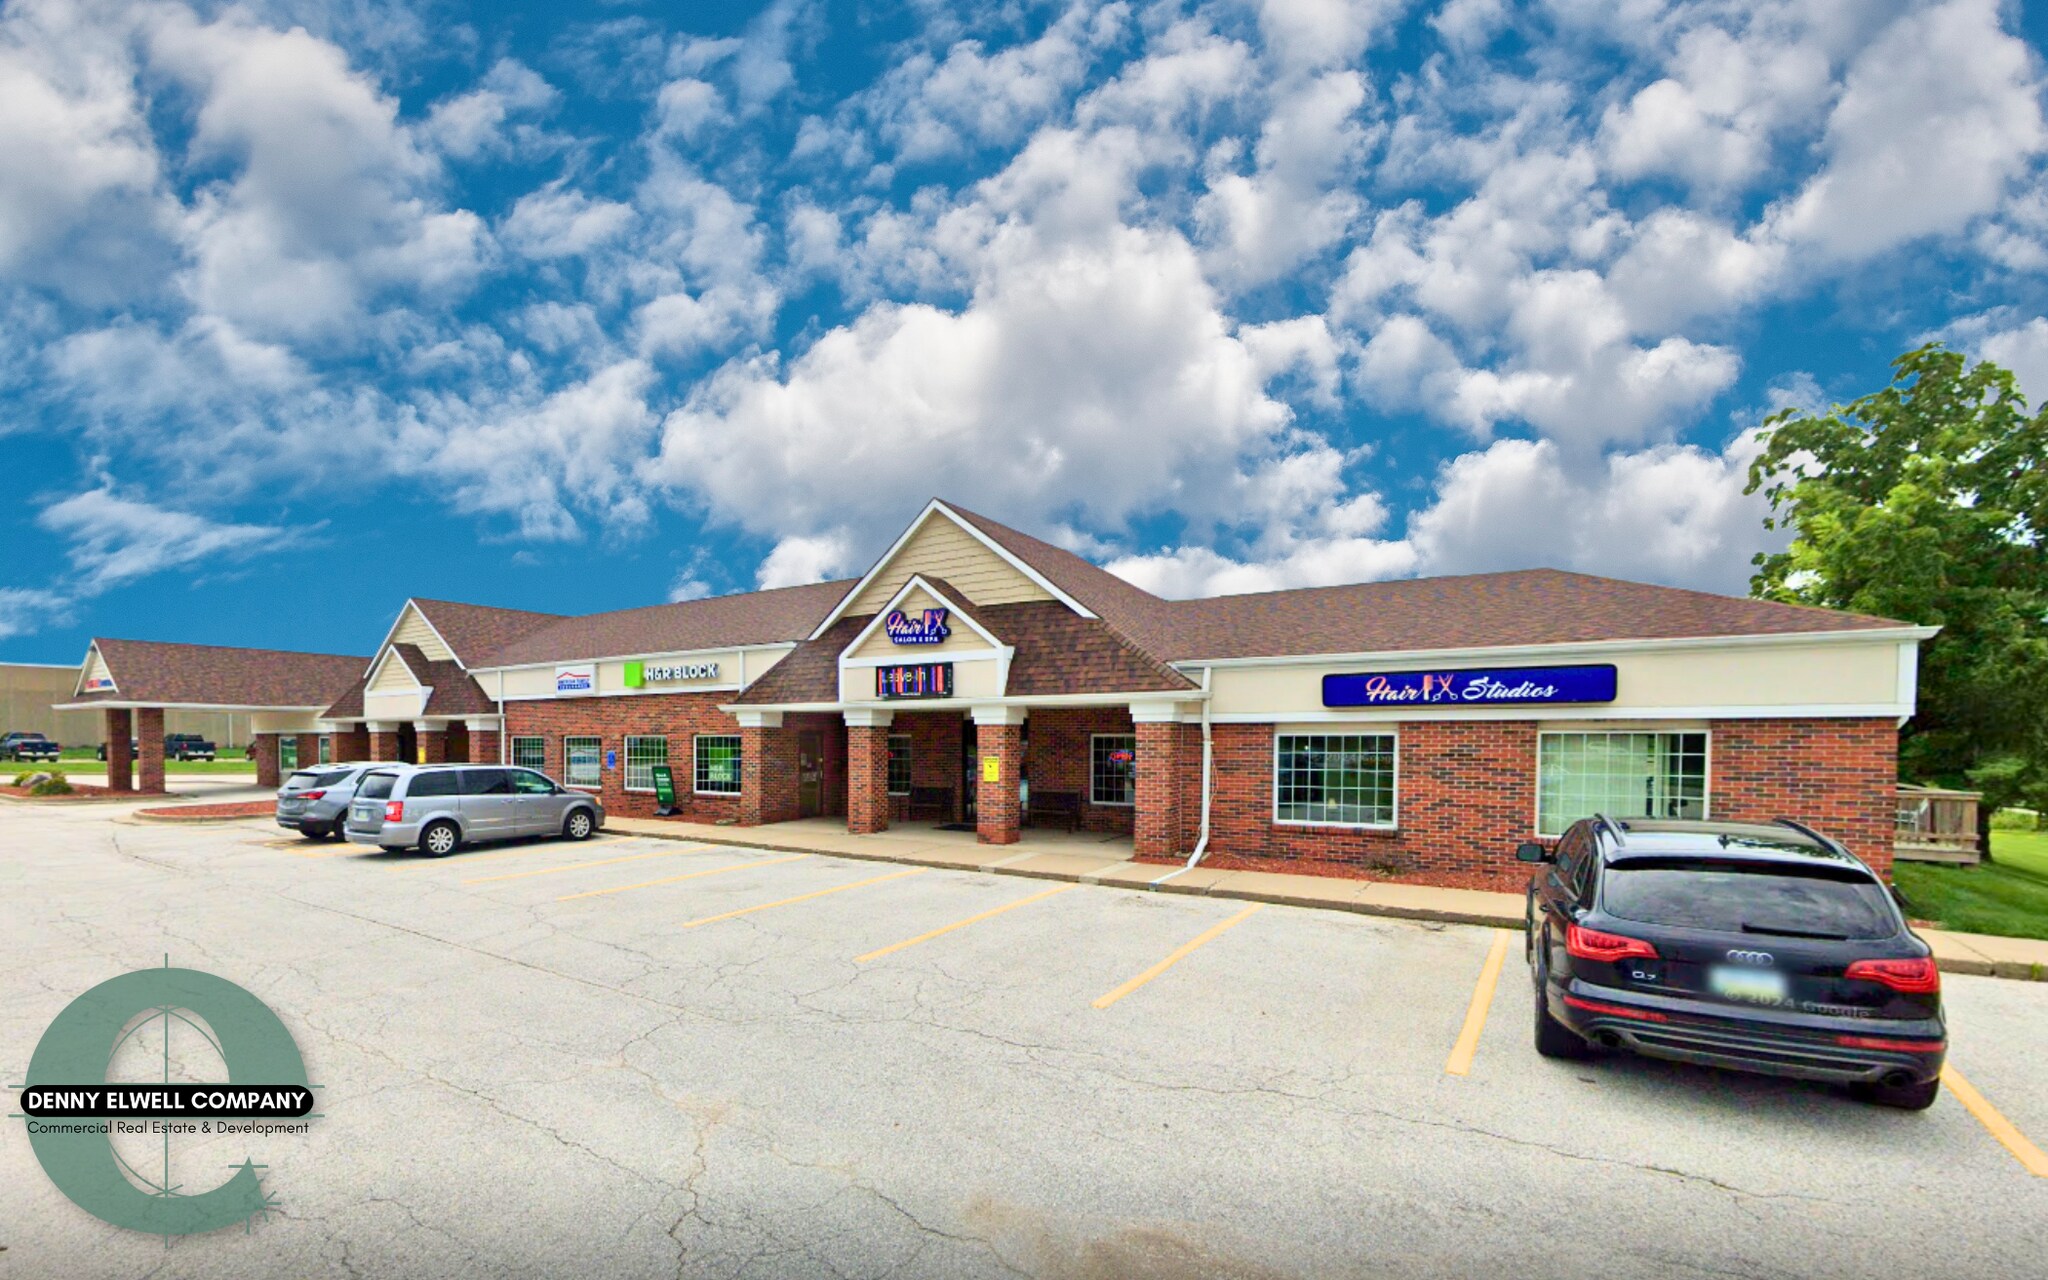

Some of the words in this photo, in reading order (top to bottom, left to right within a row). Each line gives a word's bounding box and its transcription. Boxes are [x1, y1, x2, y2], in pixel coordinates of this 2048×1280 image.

[888, 611, 922, 635] Hair
[646, 667, 672, 681] H&R
[674, 664, 718, 679] BLOCK
[1365, 676, 1424, 701] Hair
[1461, 676, 1559, 700] Studios
